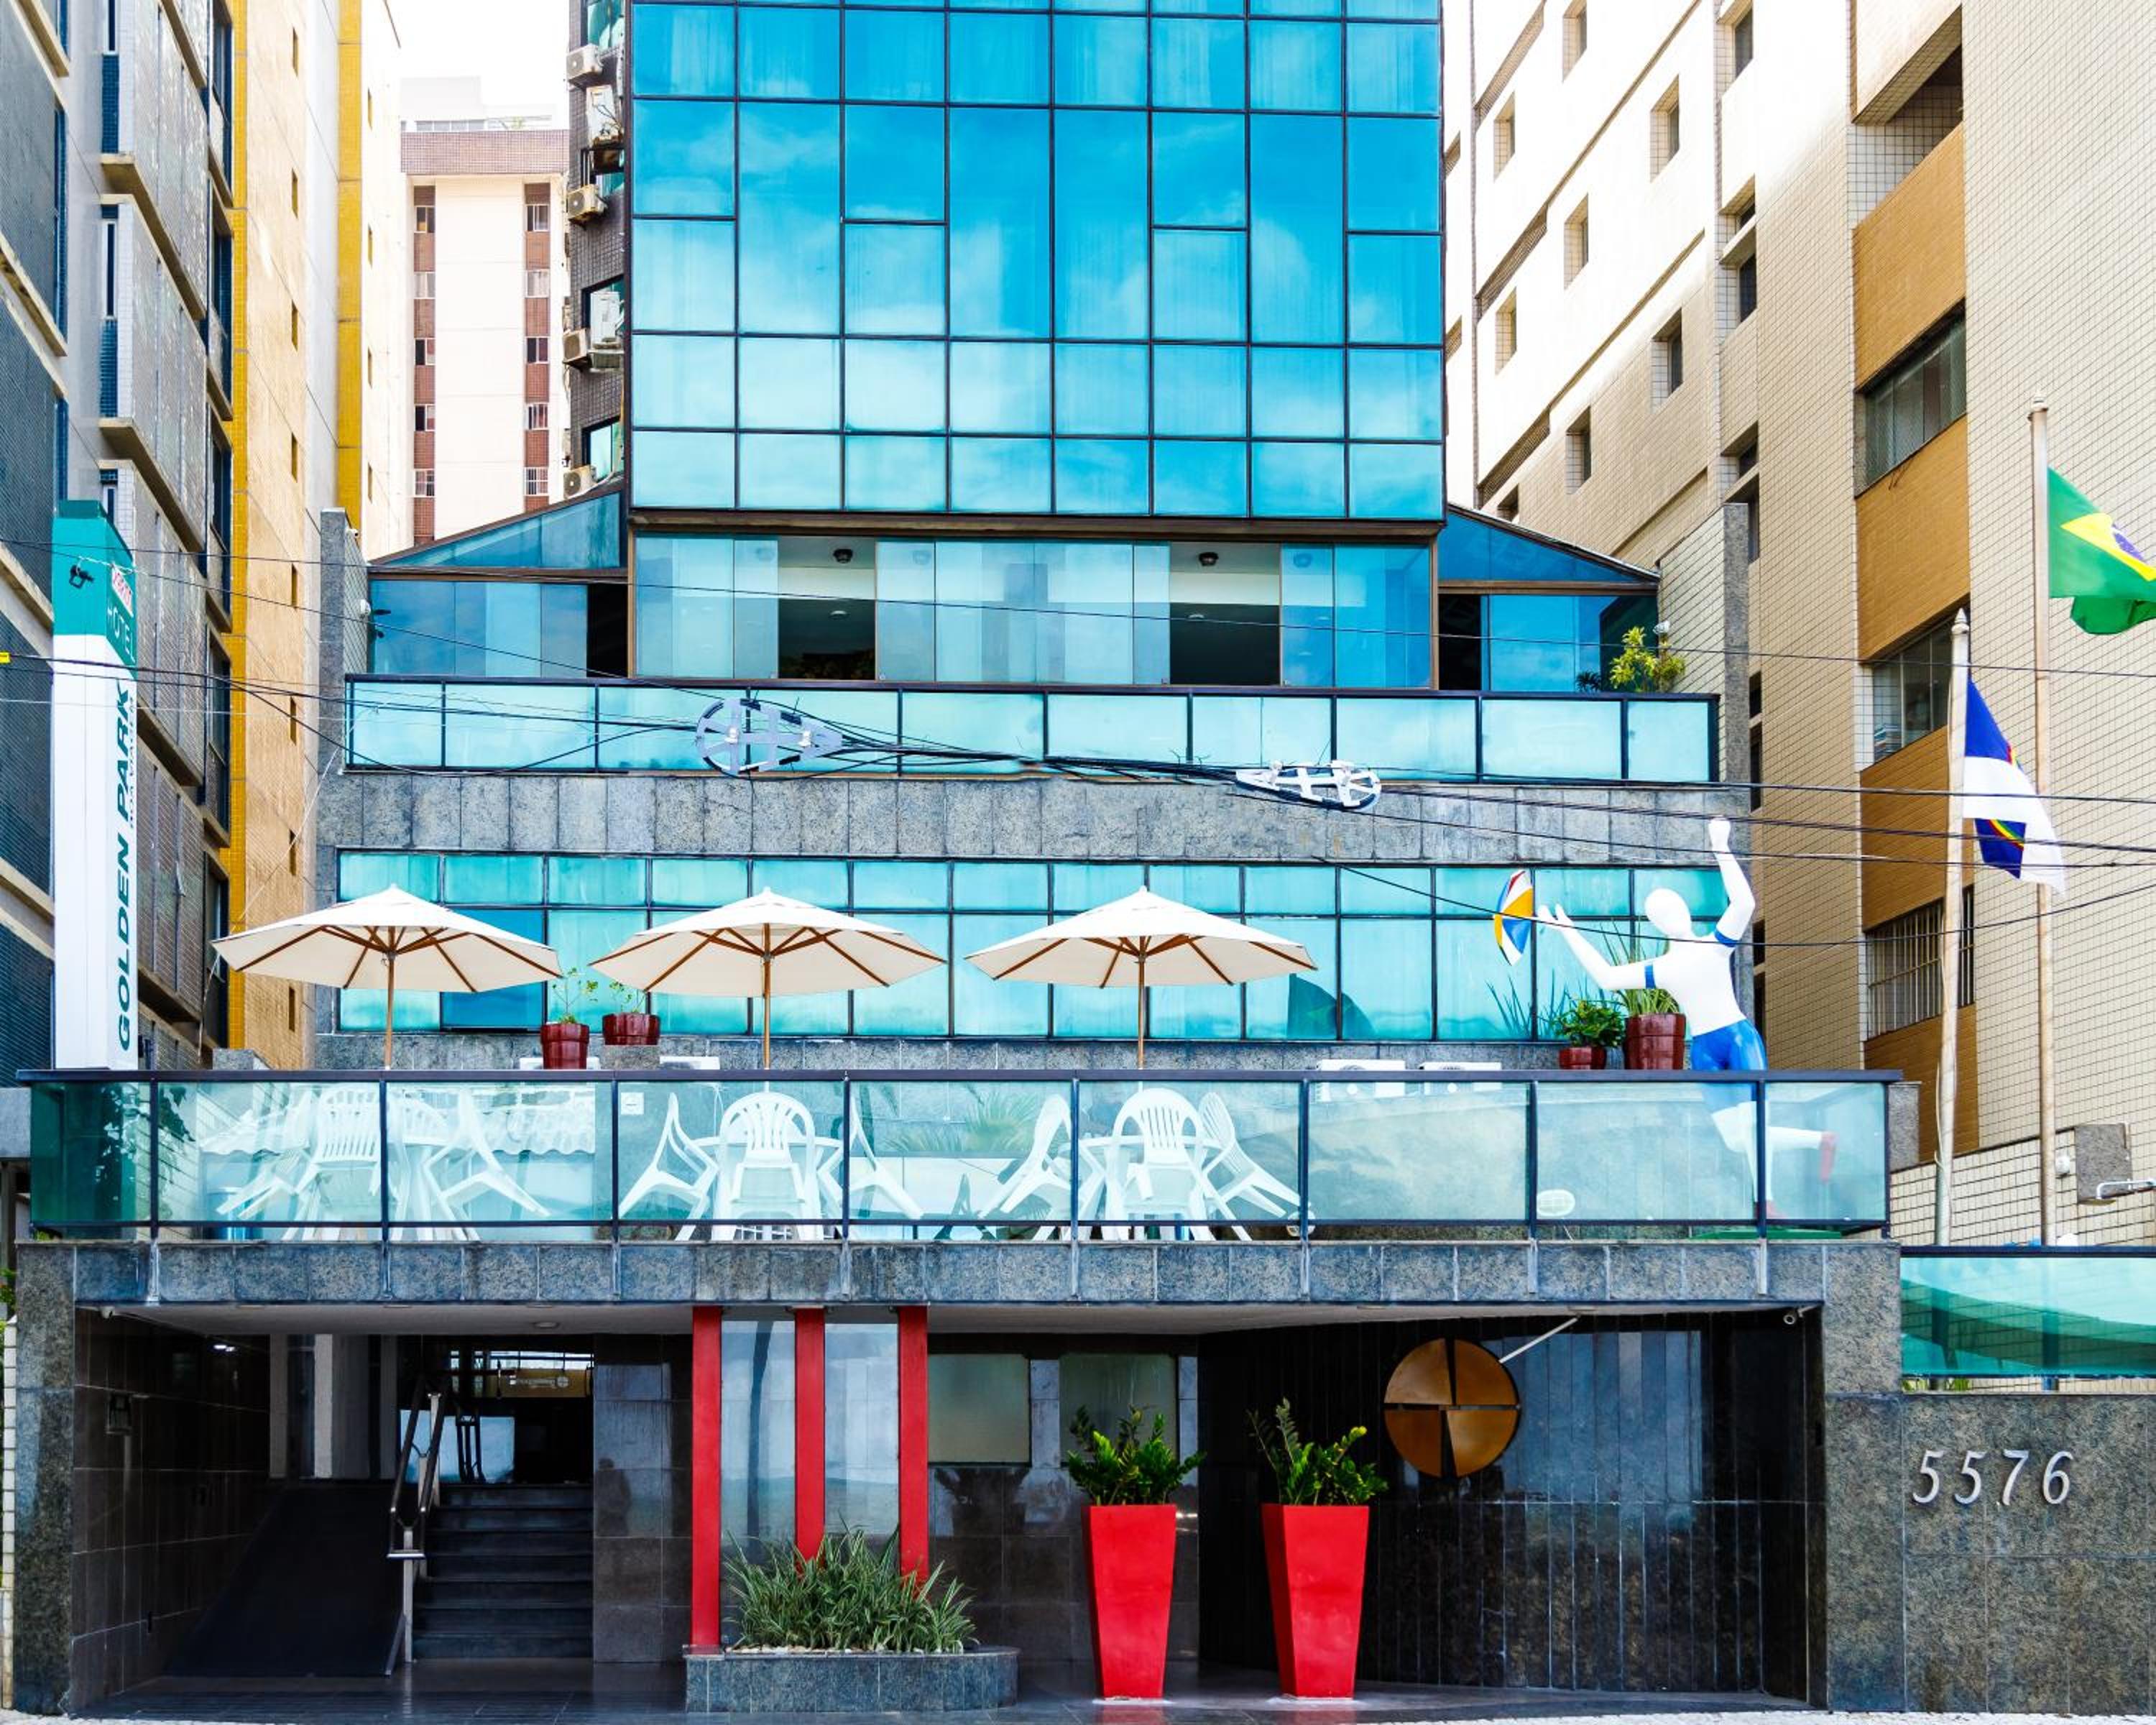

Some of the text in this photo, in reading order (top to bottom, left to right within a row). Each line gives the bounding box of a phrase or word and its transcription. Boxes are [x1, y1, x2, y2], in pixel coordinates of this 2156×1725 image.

[108, 601, 136, 663] HOTEL
[116, 677, 130, 1051] GOLDEN PARK
[1912, 1448, 2074, 1506] 5576
